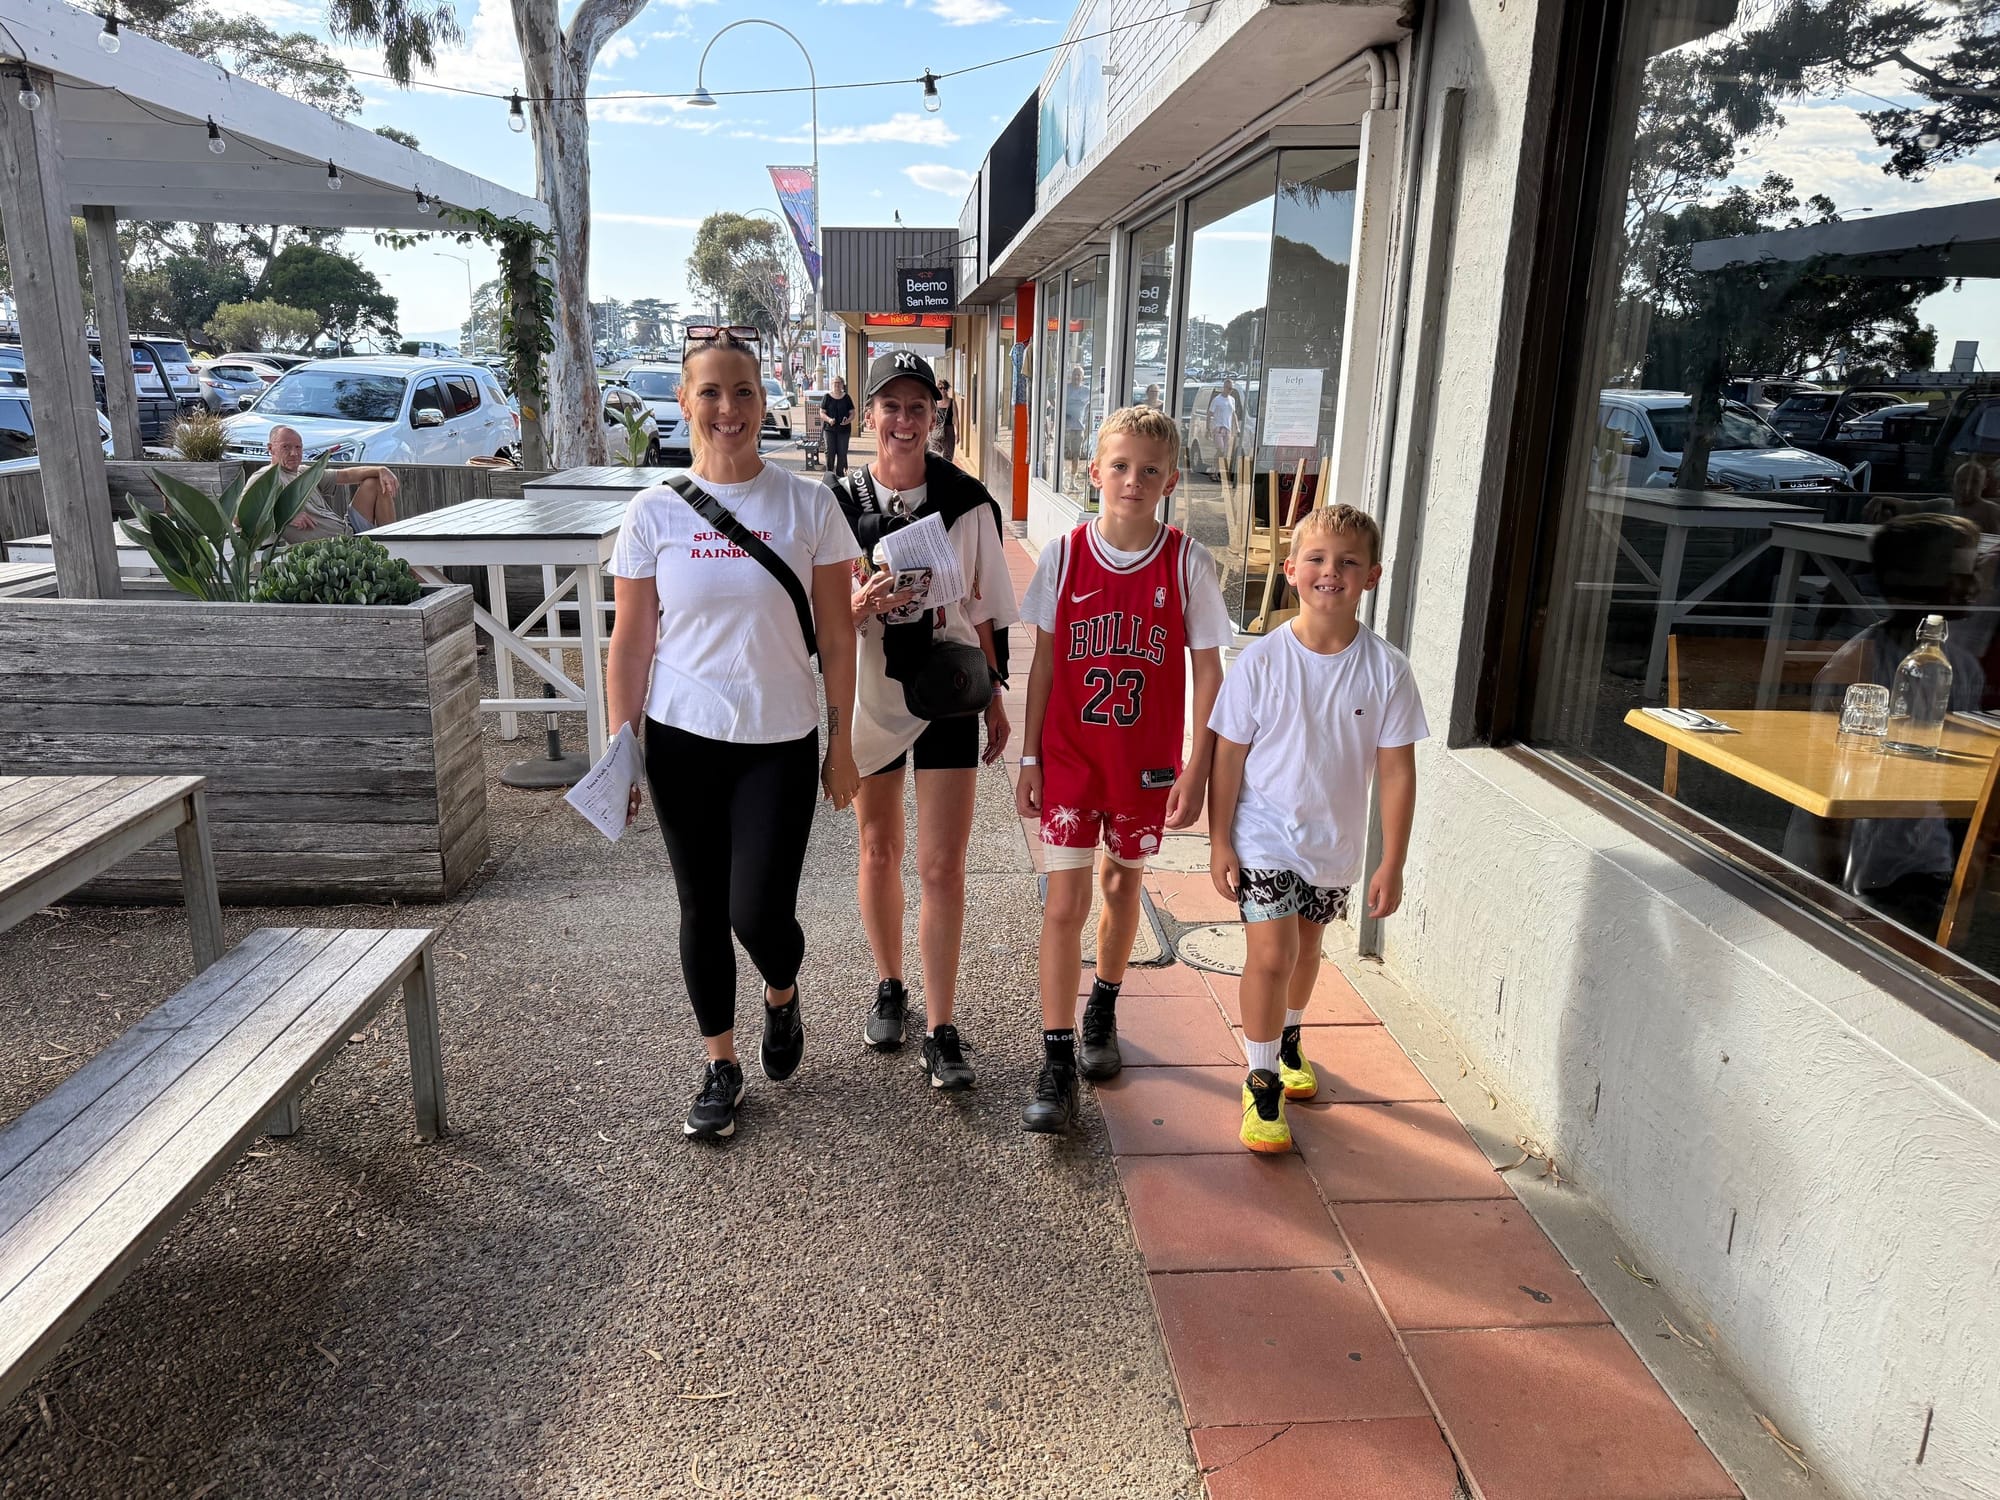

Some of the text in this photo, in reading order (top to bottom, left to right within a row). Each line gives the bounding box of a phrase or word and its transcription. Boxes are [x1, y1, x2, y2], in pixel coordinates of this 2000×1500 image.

[906, 279, 947, 292] Beemo
[906, 295, 949, 307] San Remo
[243, 446, 272, 456] ISUZ
[852, 470, 874, 513] MIMCO
[693, 530, 772, 542] SUNNE
[1068, 611, 1168, 666] BULLS
[1081, 667, 1146, 727] 23
